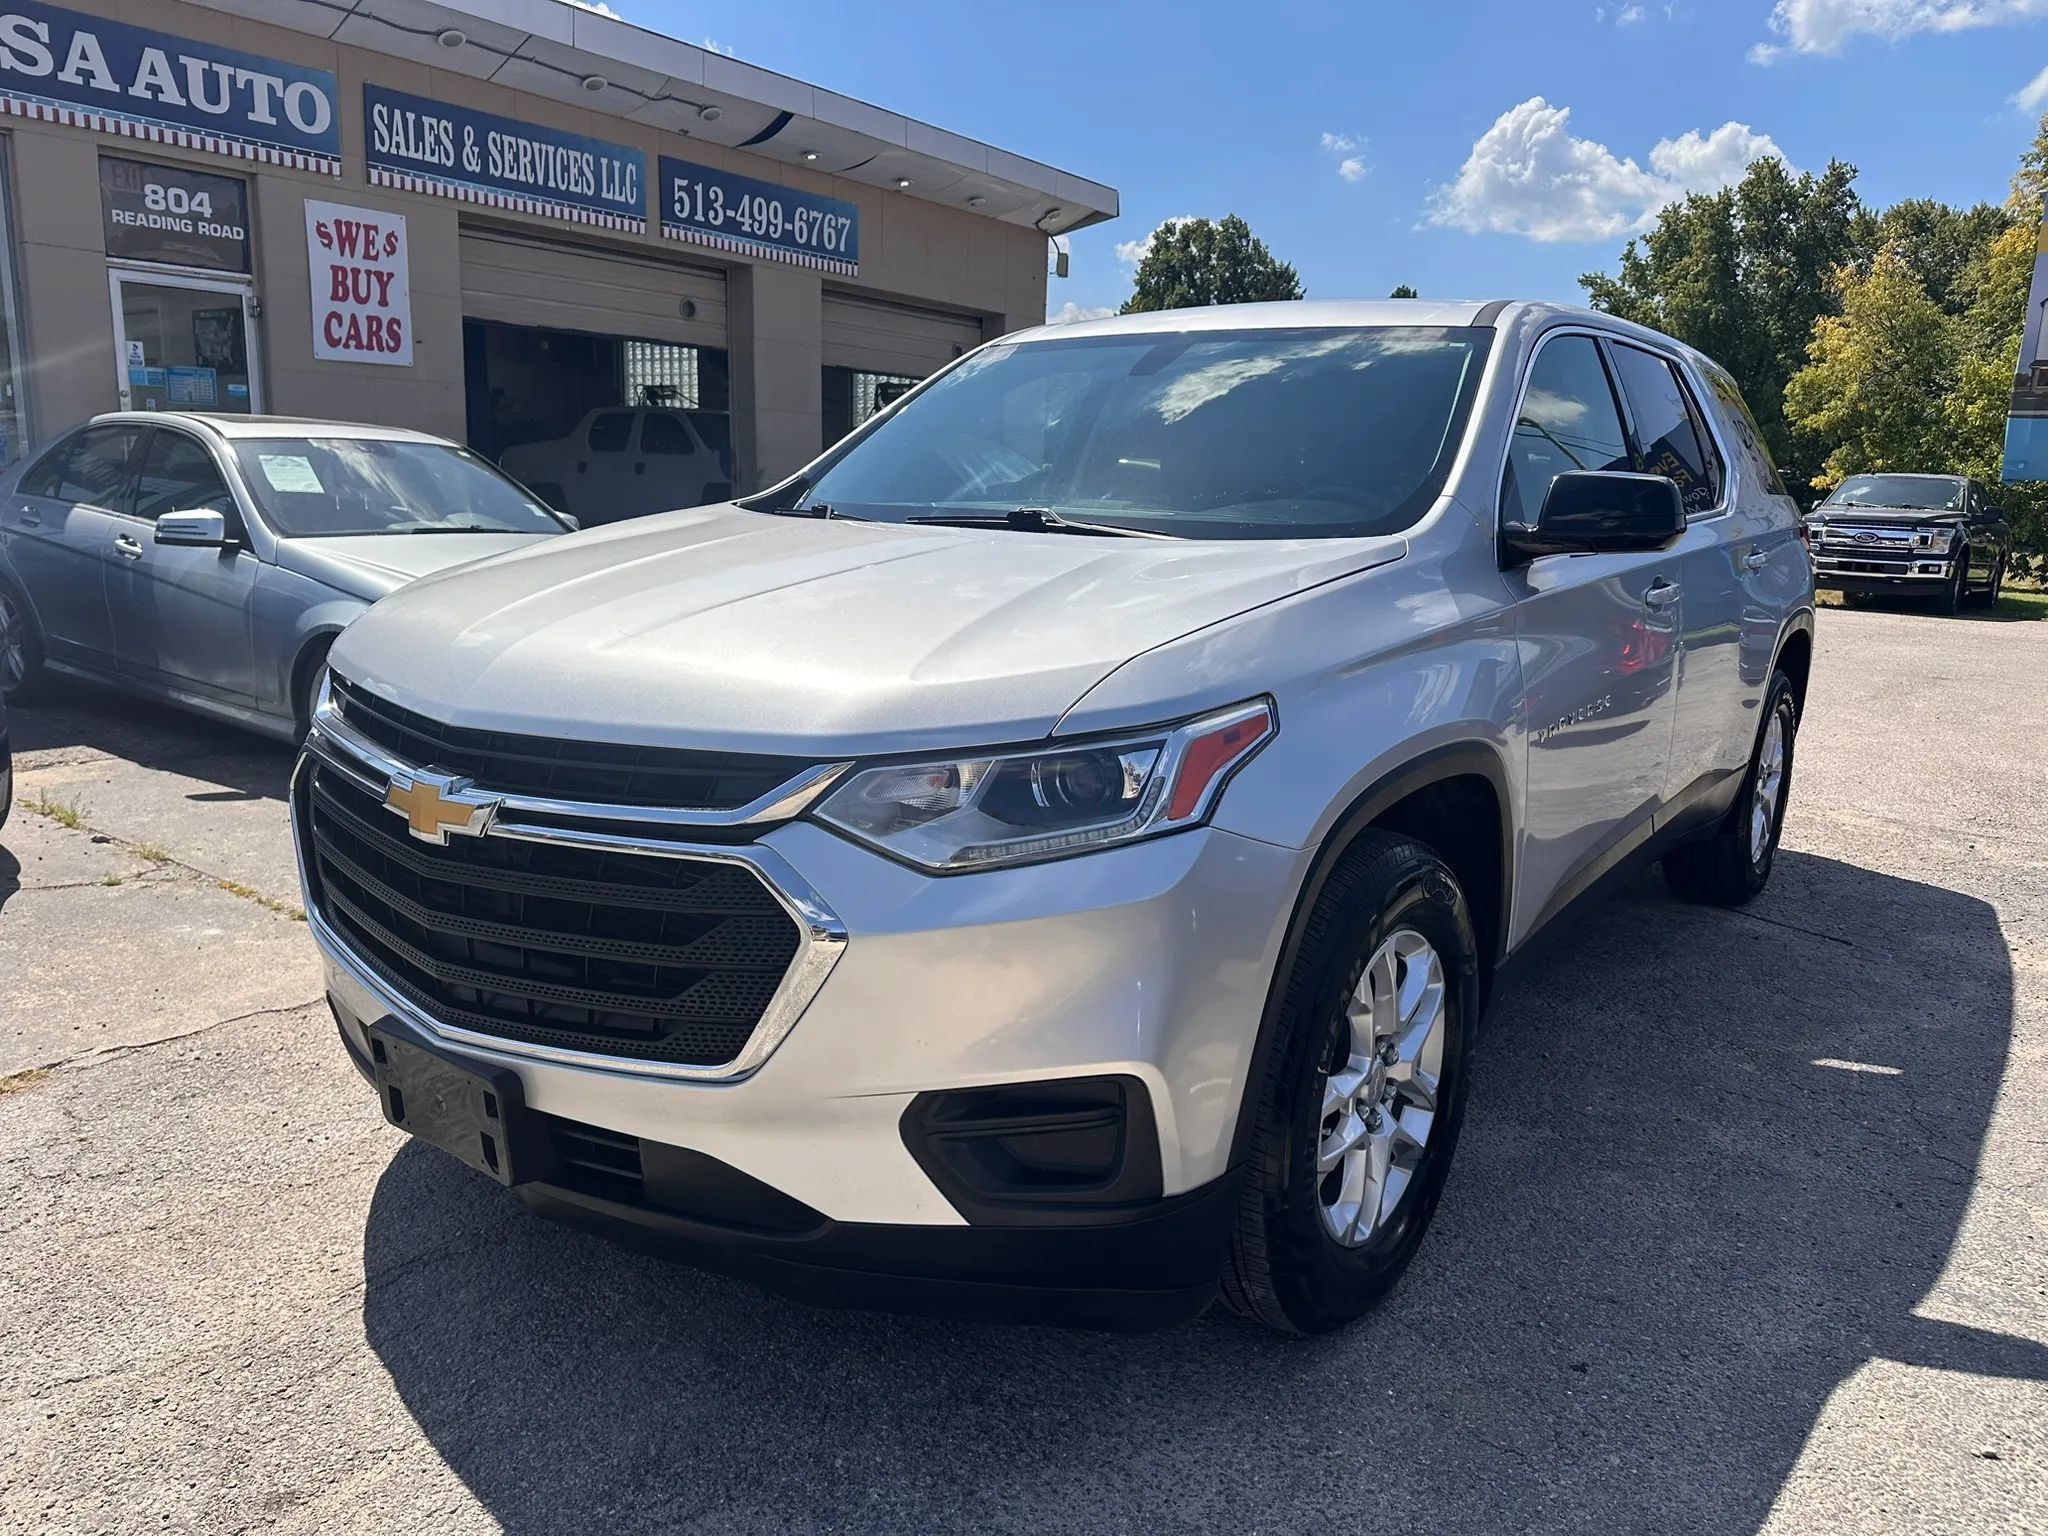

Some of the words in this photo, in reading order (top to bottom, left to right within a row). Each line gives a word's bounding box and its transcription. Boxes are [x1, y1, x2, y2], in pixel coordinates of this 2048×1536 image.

[0, 14, 120, 93] SA
[128, 47, 331, 135] AUTO
[372, 102, 455, 168] SALES
[463, 126, 481, 173] &
[488, 131, 595, 197] SERVICES
[600, 155, 637, 205] LLC
[144, 183, 213, 218] 804
[674, 178, 851, 254] 513-499-6767
[112, 209, 192, 235] READING
[198, 222, 244, 241] ROAD
[330, 265, 394, 307] BUY
[324, 310, 401, 353] CARS
